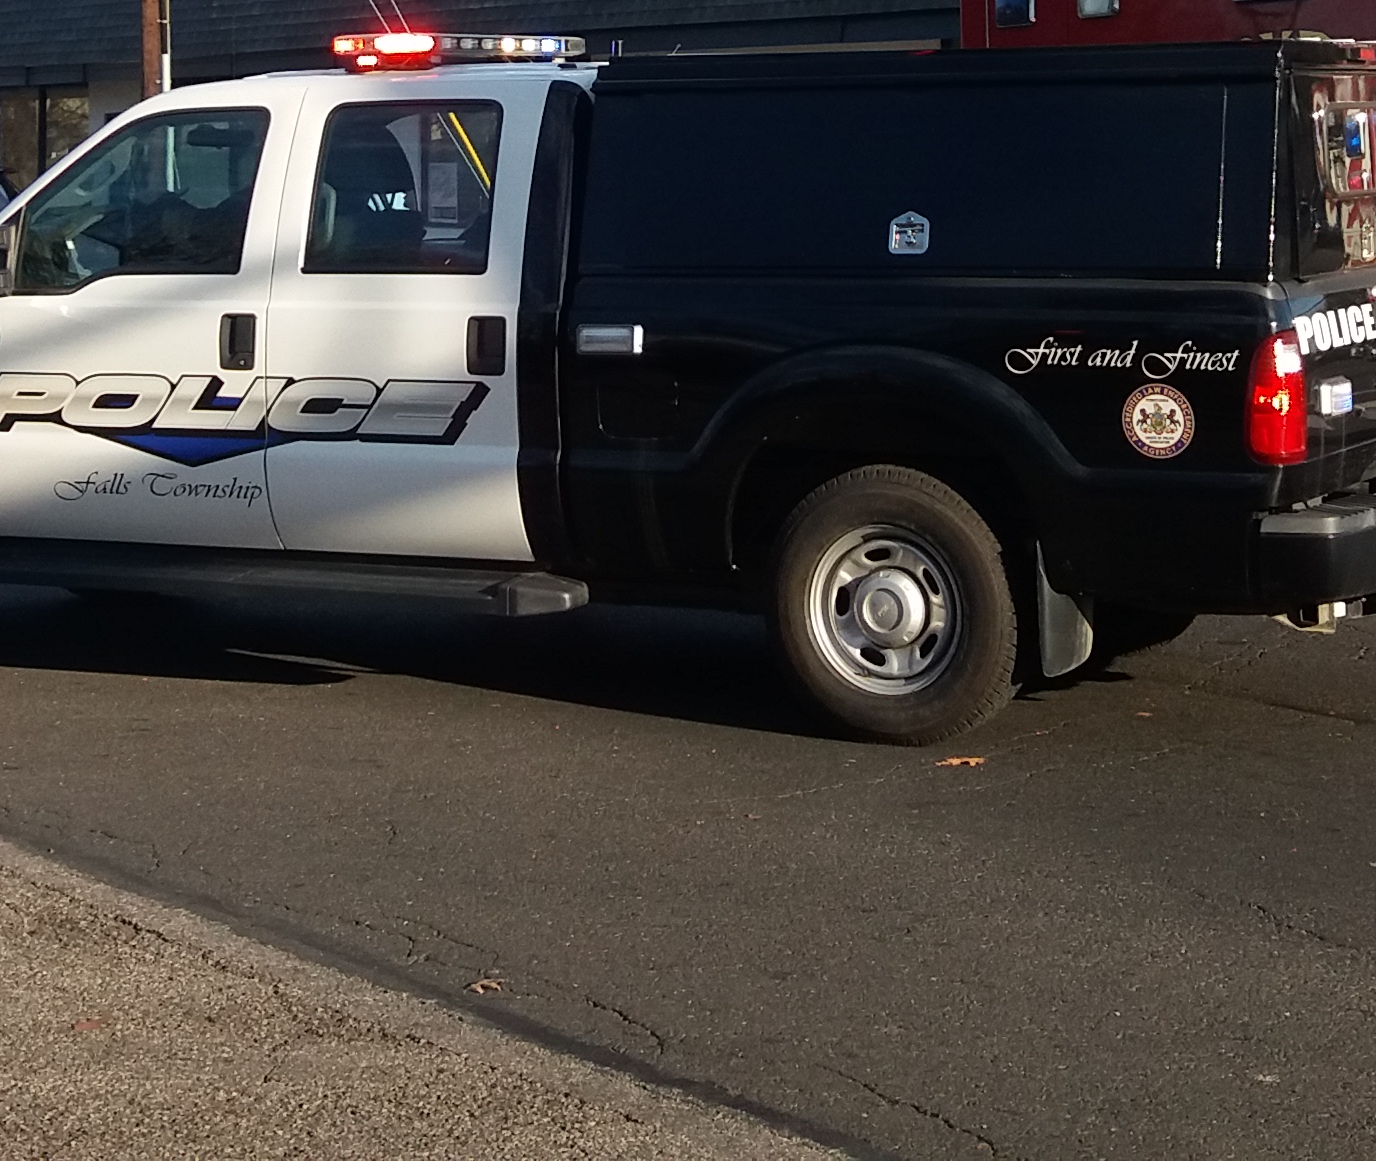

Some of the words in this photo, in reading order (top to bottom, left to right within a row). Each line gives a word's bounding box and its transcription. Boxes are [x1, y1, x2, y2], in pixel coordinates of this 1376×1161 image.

[1005, 336, 1084, 374] First
[1087, 340, 1139, 367] and
[1141, 341, 1241, 379] Finest
[54, 472, 131, 501] Falls
[141, 472, 263, 507] Township
